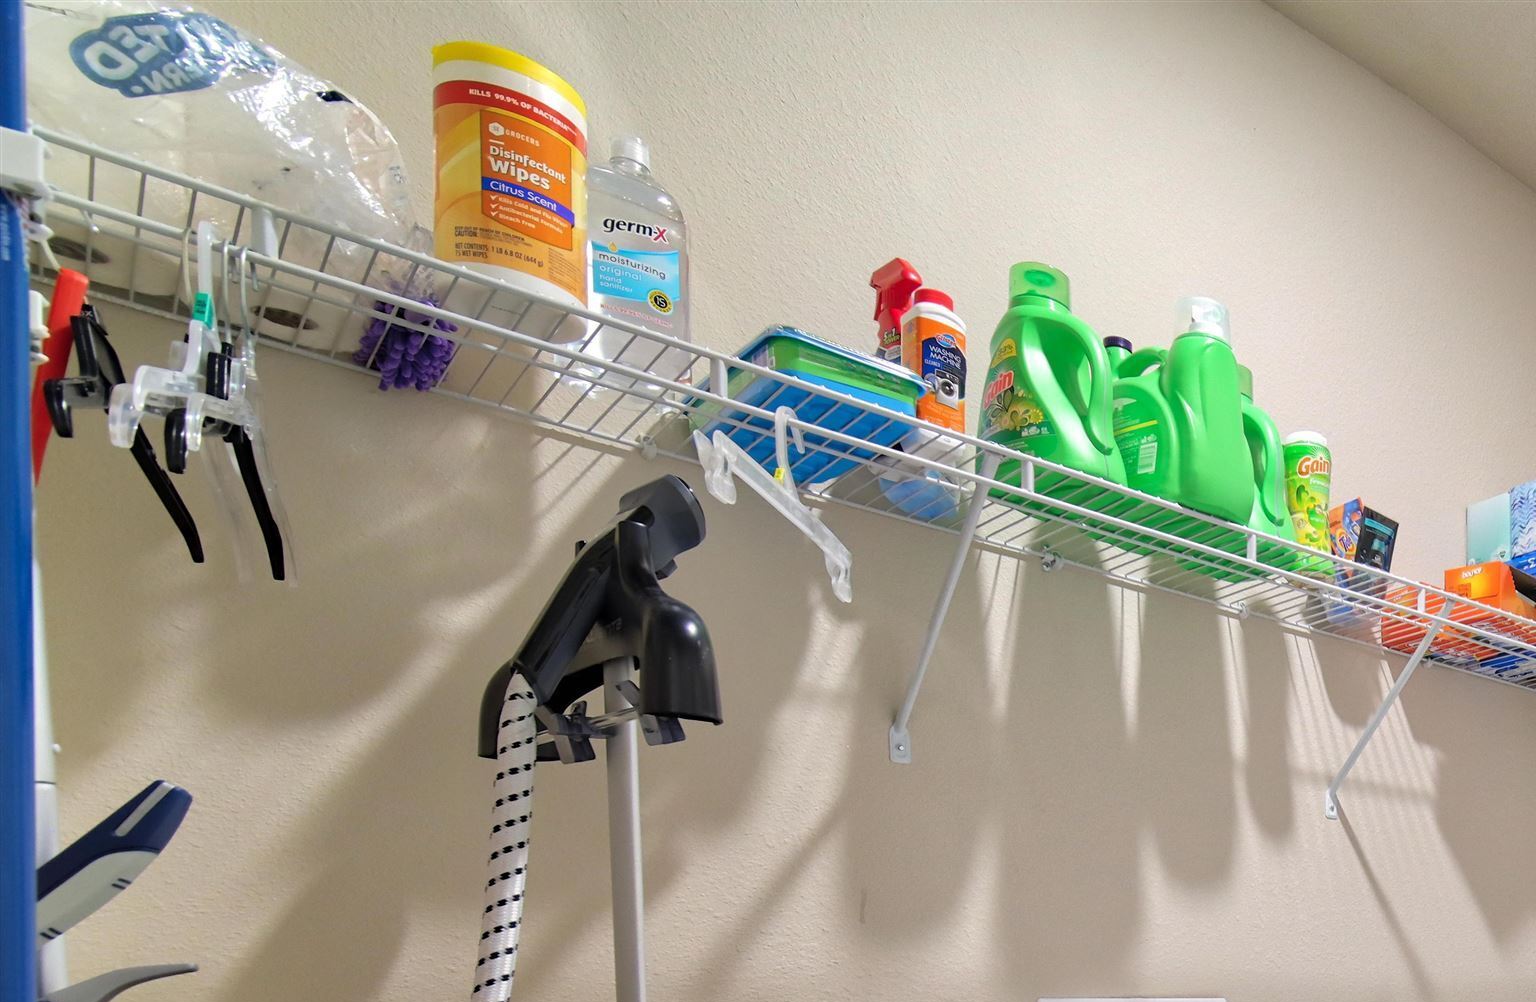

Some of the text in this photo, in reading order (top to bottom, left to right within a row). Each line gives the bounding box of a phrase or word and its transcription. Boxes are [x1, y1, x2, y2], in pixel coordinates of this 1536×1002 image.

[469, 88, 491, 98] KILLS
[494, 93, 519, 106] 99.9%
[520, 101, 533, 110] OF
[505, 129, 540, 147] GROCERS
[487, 155, 550, 190] Wipes
[489, 145, 567, 184] Disinfectant
[490, 180, 557, 212] Citrus Scent
[598, 253, 667, 280] moisturizing
[599, 265, 642, 281] original
[929, 344, 962, 363] WASHING
[929, 352, 961, 369] MACHINE
[1297, 456, 1330, 477] Gain
